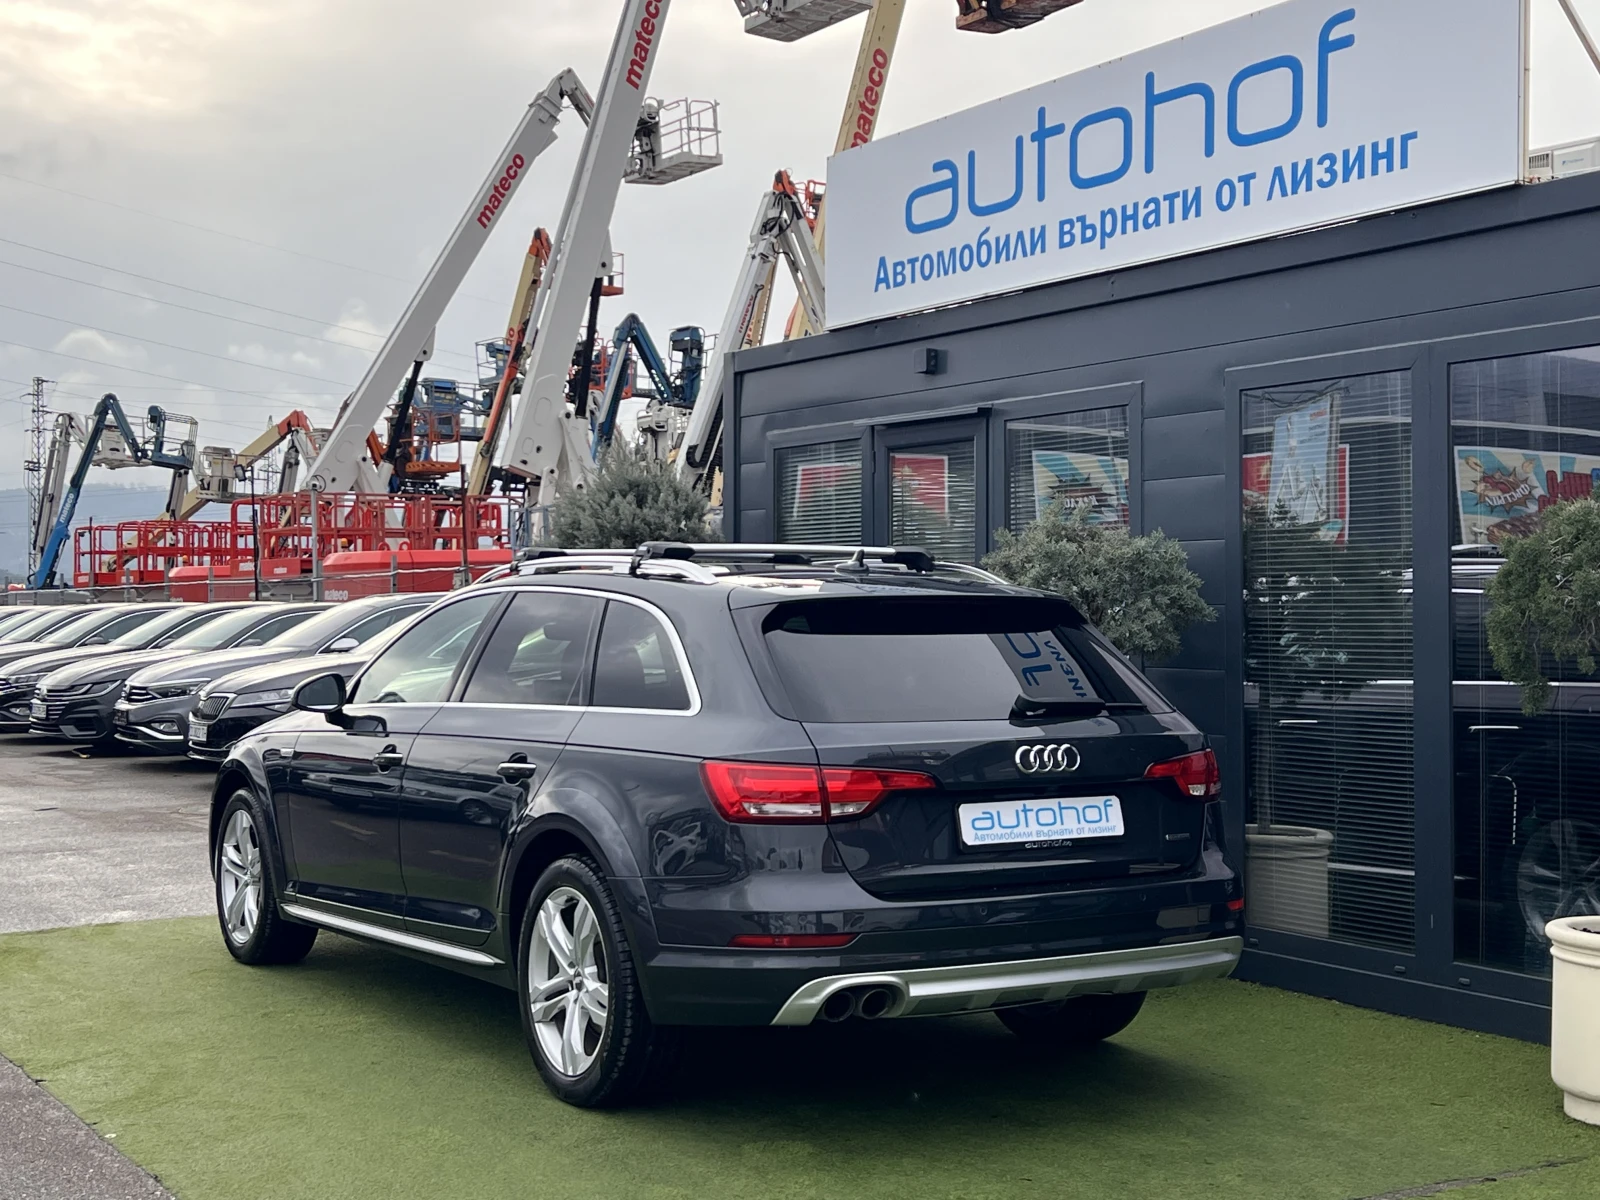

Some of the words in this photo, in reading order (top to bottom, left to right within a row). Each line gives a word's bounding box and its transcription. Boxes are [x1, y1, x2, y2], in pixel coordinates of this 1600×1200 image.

[626, 0, 663, 90] matec
[905, 7, 1355, 235] autohof
[477, 153, 525, 230] mateco
[874, 226, 1047, 293] Автомобили
[1058, 185, 1202, 250] върнати
[1215, 172, 1256, 212] от
[1267, 130, 1418, 201] лизинг
[971, 798, 1114, 831] autohof
[973, 829, 1034, 842] Автомобили
[1036, 826, 1074, 839] върнати
[1077, 826, 1086, 836] от
[1087, 824, 1117, 834] лизинг
